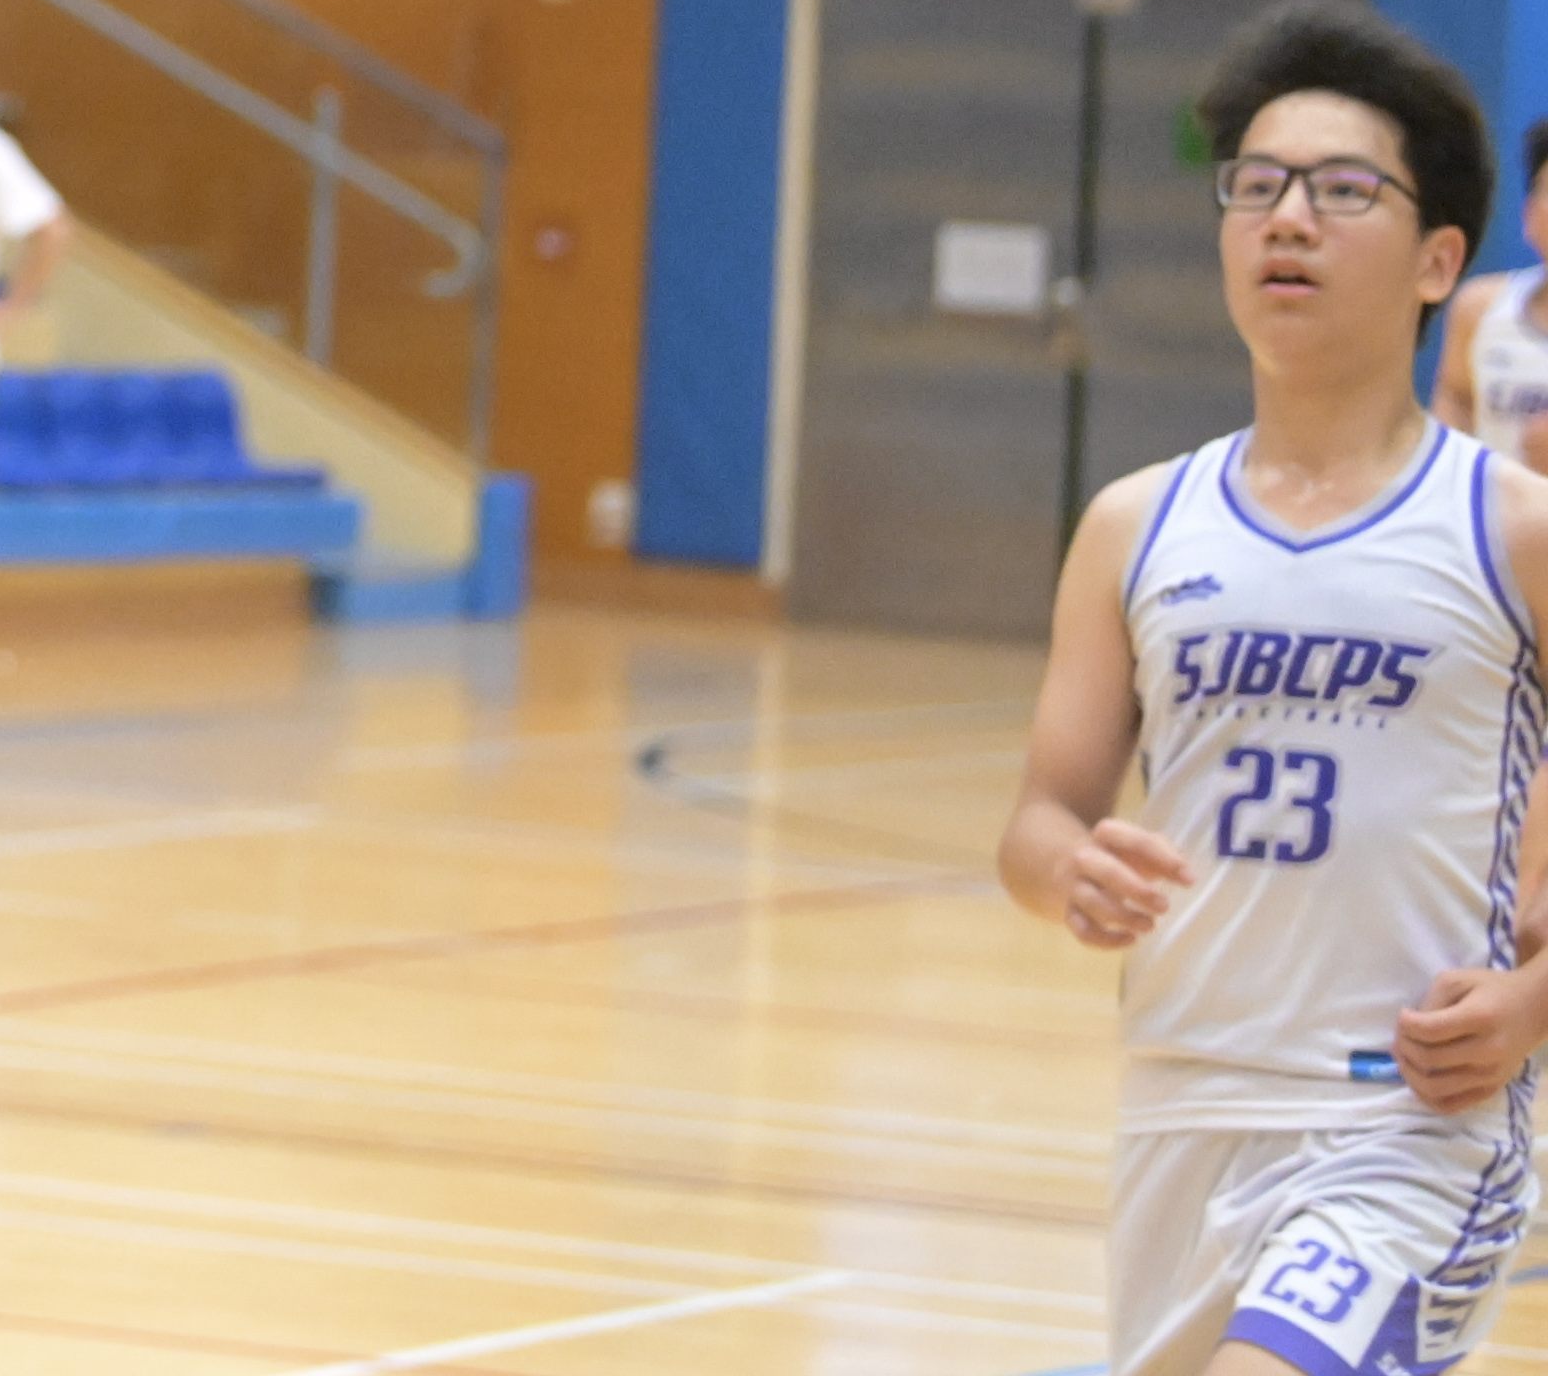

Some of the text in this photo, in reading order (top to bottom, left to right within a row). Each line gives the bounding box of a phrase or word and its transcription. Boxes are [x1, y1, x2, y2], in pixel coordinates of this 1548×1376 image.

[1172, 628, 1433, 708] SJBCPS
[1216, 745, 1338, 864] 23
[1259, 1238, 1372, 1324] 23
